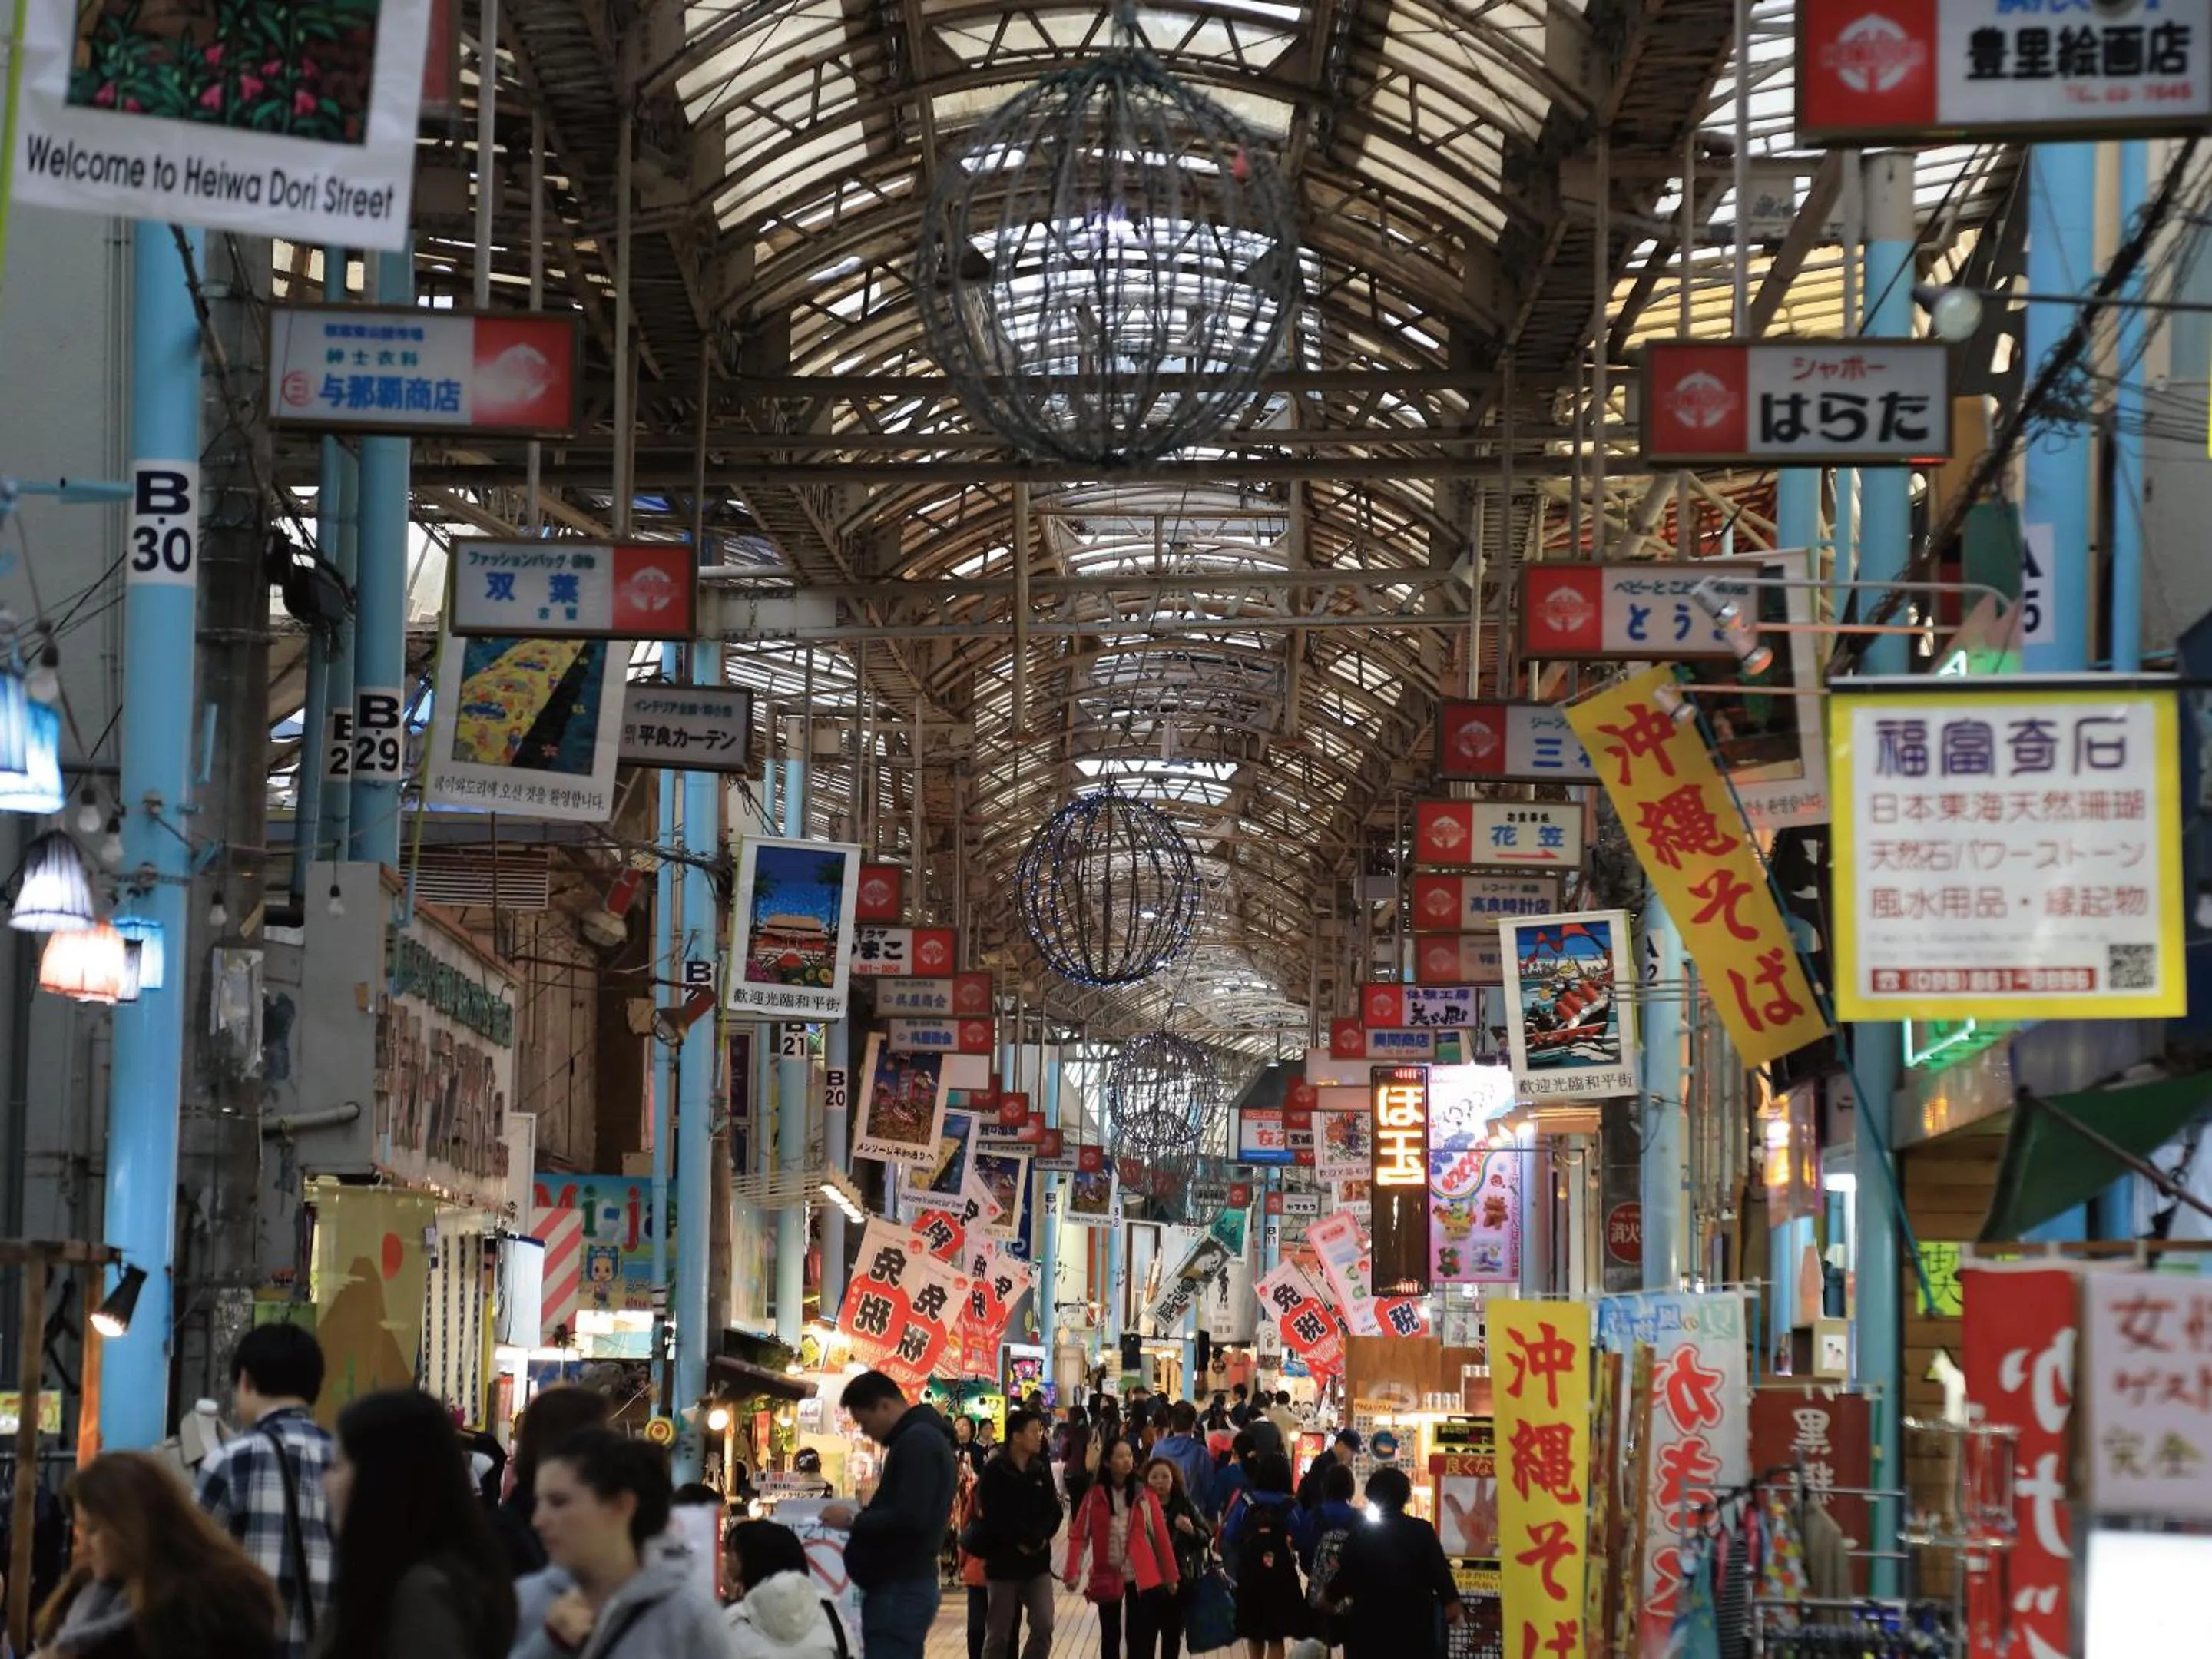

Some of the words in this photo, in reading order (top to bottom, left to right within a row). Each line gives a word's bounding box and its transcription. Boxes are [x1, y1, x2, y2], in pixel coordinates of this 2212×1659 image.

[1966, 21, 2192, 81] 豊里絵画店
[26, 134, 145, 189] Welcome
[153, 157, 177, 190] to
[184, 158, 262, 204] Heiwa
[269, 168, 317, 212] Dori
[324, 184, 394, 220] Street
[319, 373, 461, 412] 与那覇商店
[1760, 390, 1930, 444] はらた
[132, 526, 191, 573] 30
[638, 724, 737, 750] 平良カーテン
[1874, 717, 2128, 778] 福富奇石
[329, 747, 351, 774] 2
[356, 737, 399, 772] 29
[1869, 790, 2146, 824] 日本東海天然珊瑚
[1491, 825, 1565, 848] 花笠
[1597, 703, 1806, 1032] 沖縄そば
[1869, 839, 2147, 873] 天然石パワーストーン
[784, 1037, 804, 1055] 21
[826, 1091, 846, 1107] 20
[1611, 1222, 1643, 1243] 消火
[1273, 1283, 1328, 1343] 免税
[1388, 1302, 1421, 1336] 税
[1445, 1457, 1495, 1475] 良くな
